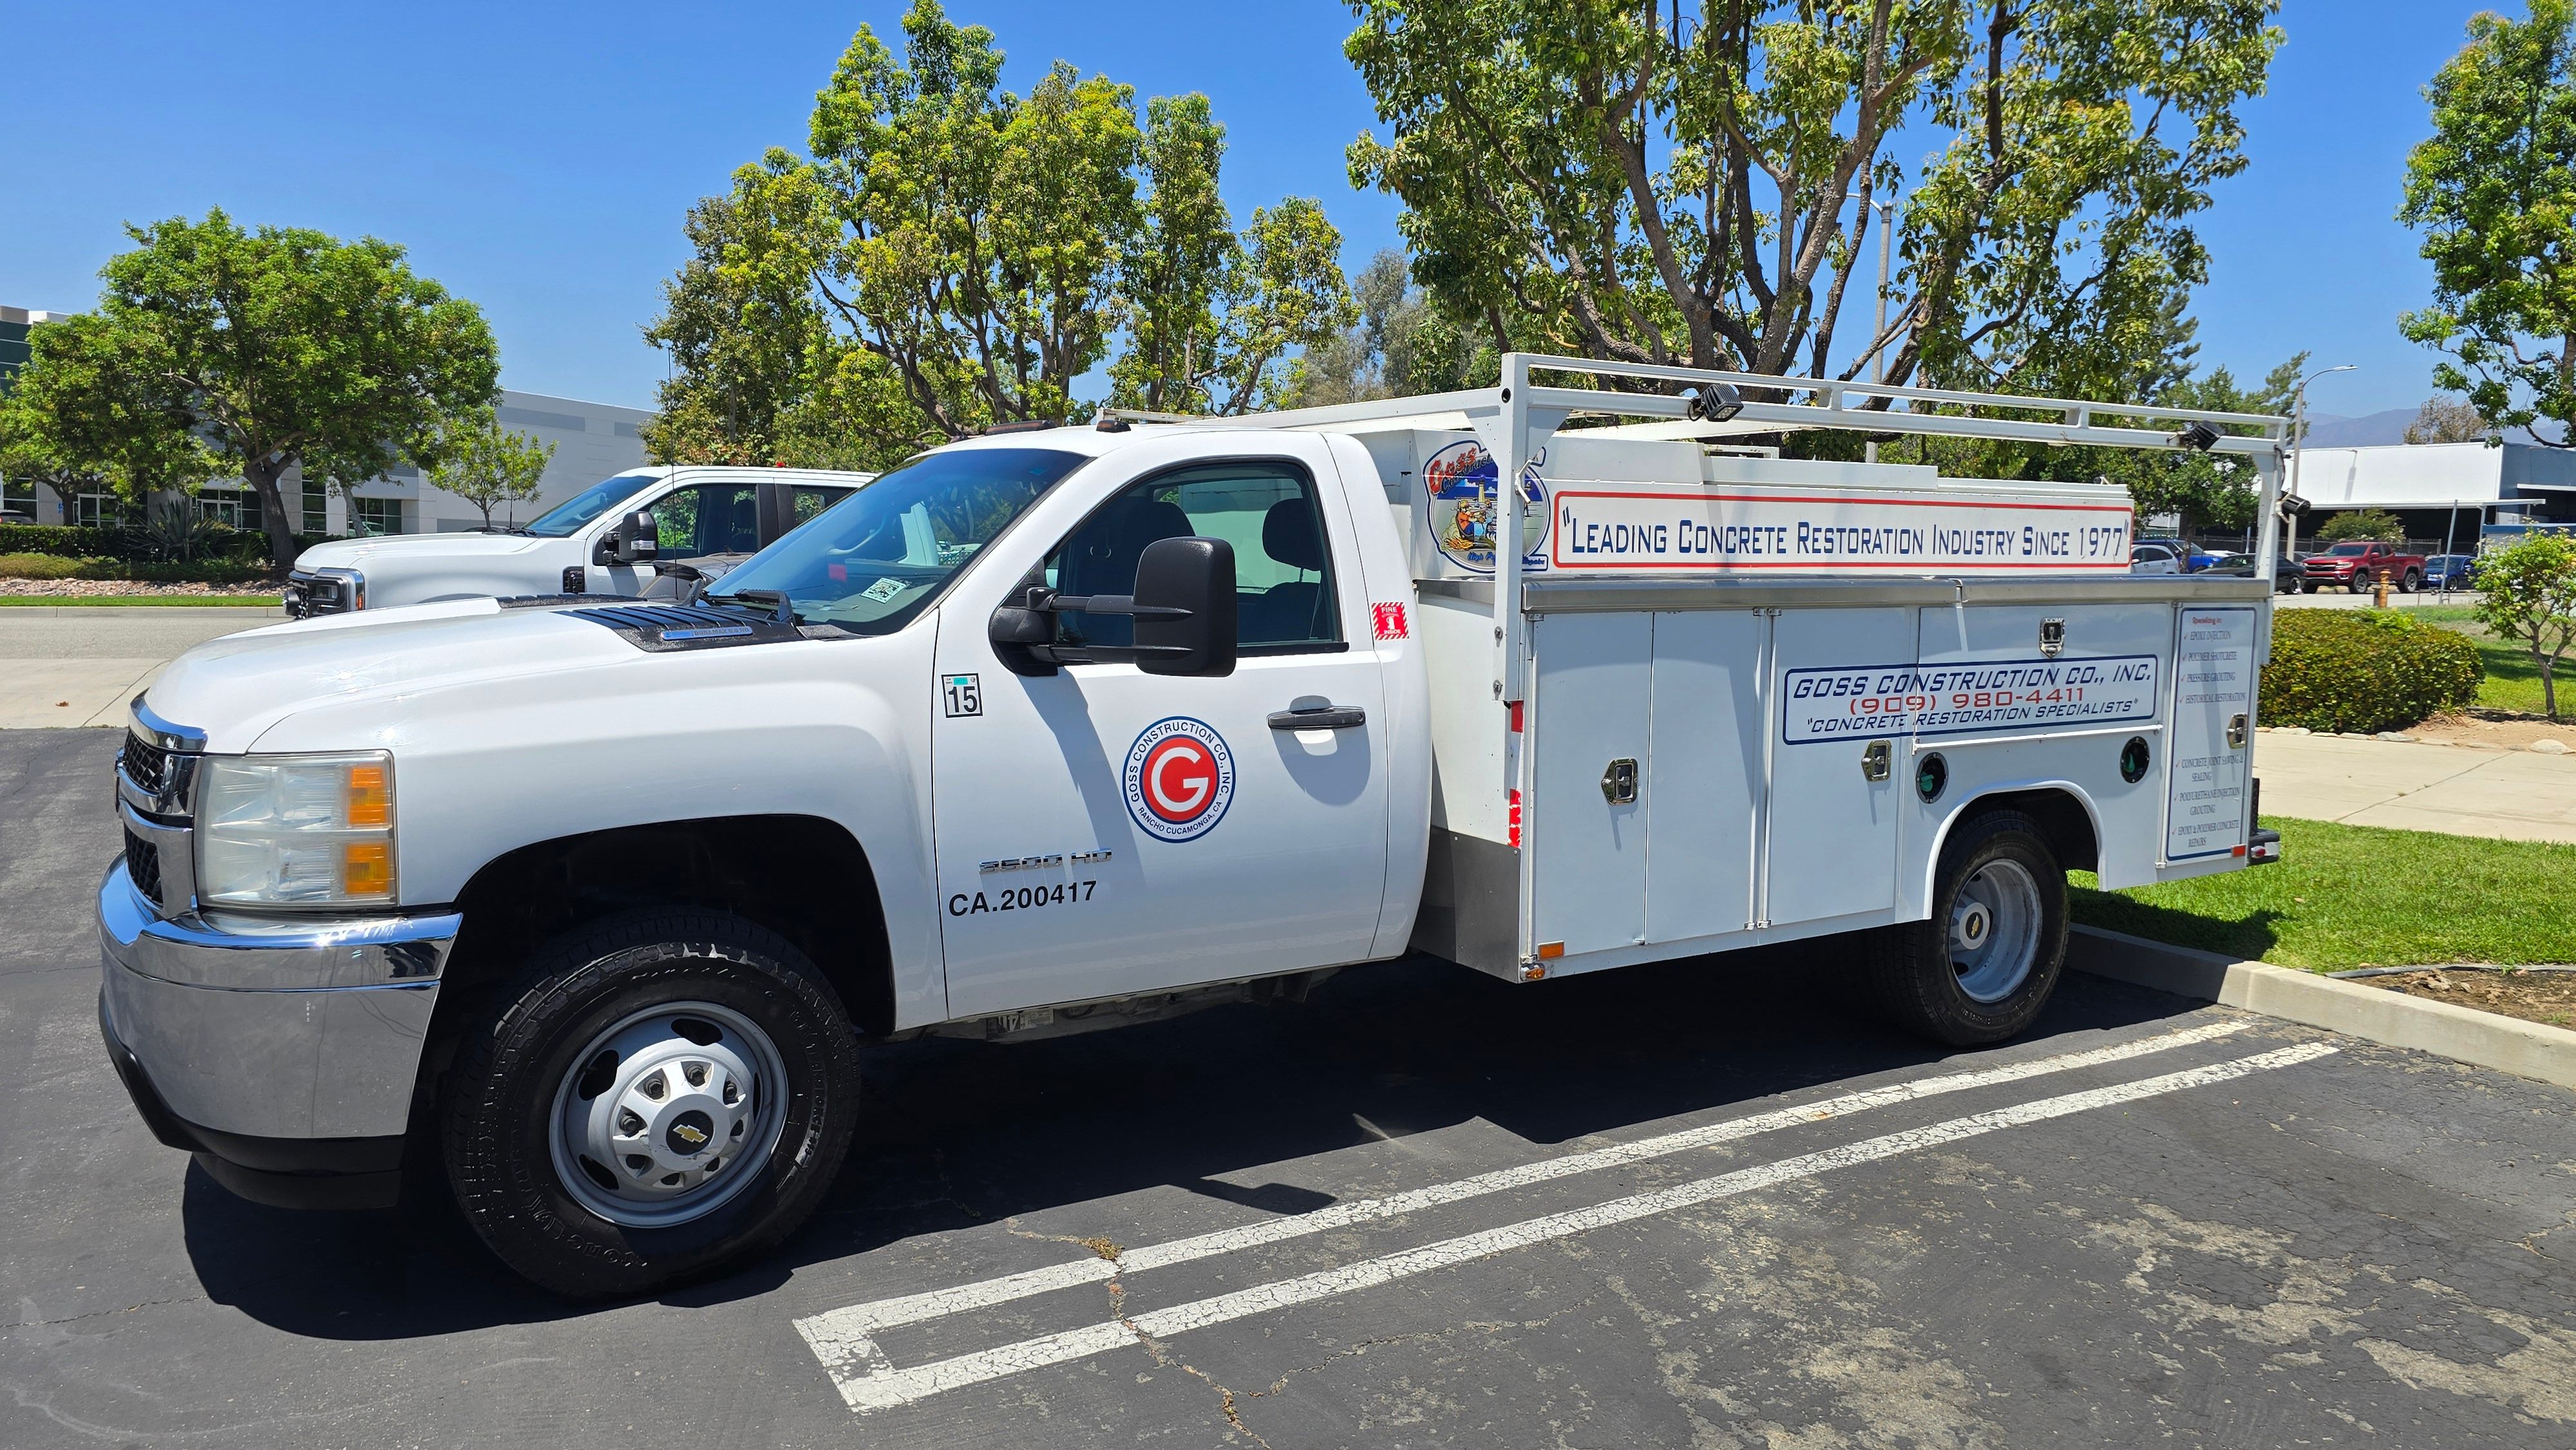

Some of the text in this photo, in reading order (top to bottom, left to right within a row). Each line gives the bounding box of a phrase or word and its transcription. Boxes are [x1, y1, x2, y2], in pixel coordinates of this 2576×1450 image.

[1562, 505, 2129, 557] "LEADING CONCRETE RESTORATION INDUSTRY SINCE 1977"
[2190, 630, 2231, 641] EPOXY INJECTION
[2188, 651, 2237, 661] POLYMER SHOTCRETE
[1794, 664, 2151, 699] GOSS CONSTRUCTION CO., INC.
[2186, 672, 2236, 683] PRESSURE GROUTING
[948, 686, 978, 713] 15
[1850, 687, 2083, 715] (909) 980-4411
[2185, 692, 2246, 704] HISTORICAL RESTORATION
[1807, 697, 2139, 733] "CONCRETE RESTORATION SPECIALISTS"
[1128, 722, 1231, 802] GOSS CONSTRUCTION CO., INC.
[2181, 757, 2207, 768] CONCRETE
[2207, 756, 2221, 768] JOINT
[1151, 746, 1209, 813] G
[2192, 772, 2212, 782] SEALING
[2179, 786, 2241, 802] POLYURETHANE INJECTION
[1138, 801, 1222, 834] RANCHO CUCAMONGA, CA
[2190, 804, 2216, 816] GROUTING
[2178, 825, 2192, 835] EPOXY
[2197, 823, 2216, 832] POLYMER
[2216, 820, 2239, 831] CONCRETE
[2188, 837, 2207, 847] REPAIRS
[979, 849, 1112, 872] 3500 HD
[949, 880, 1097, 917] CA.200417
